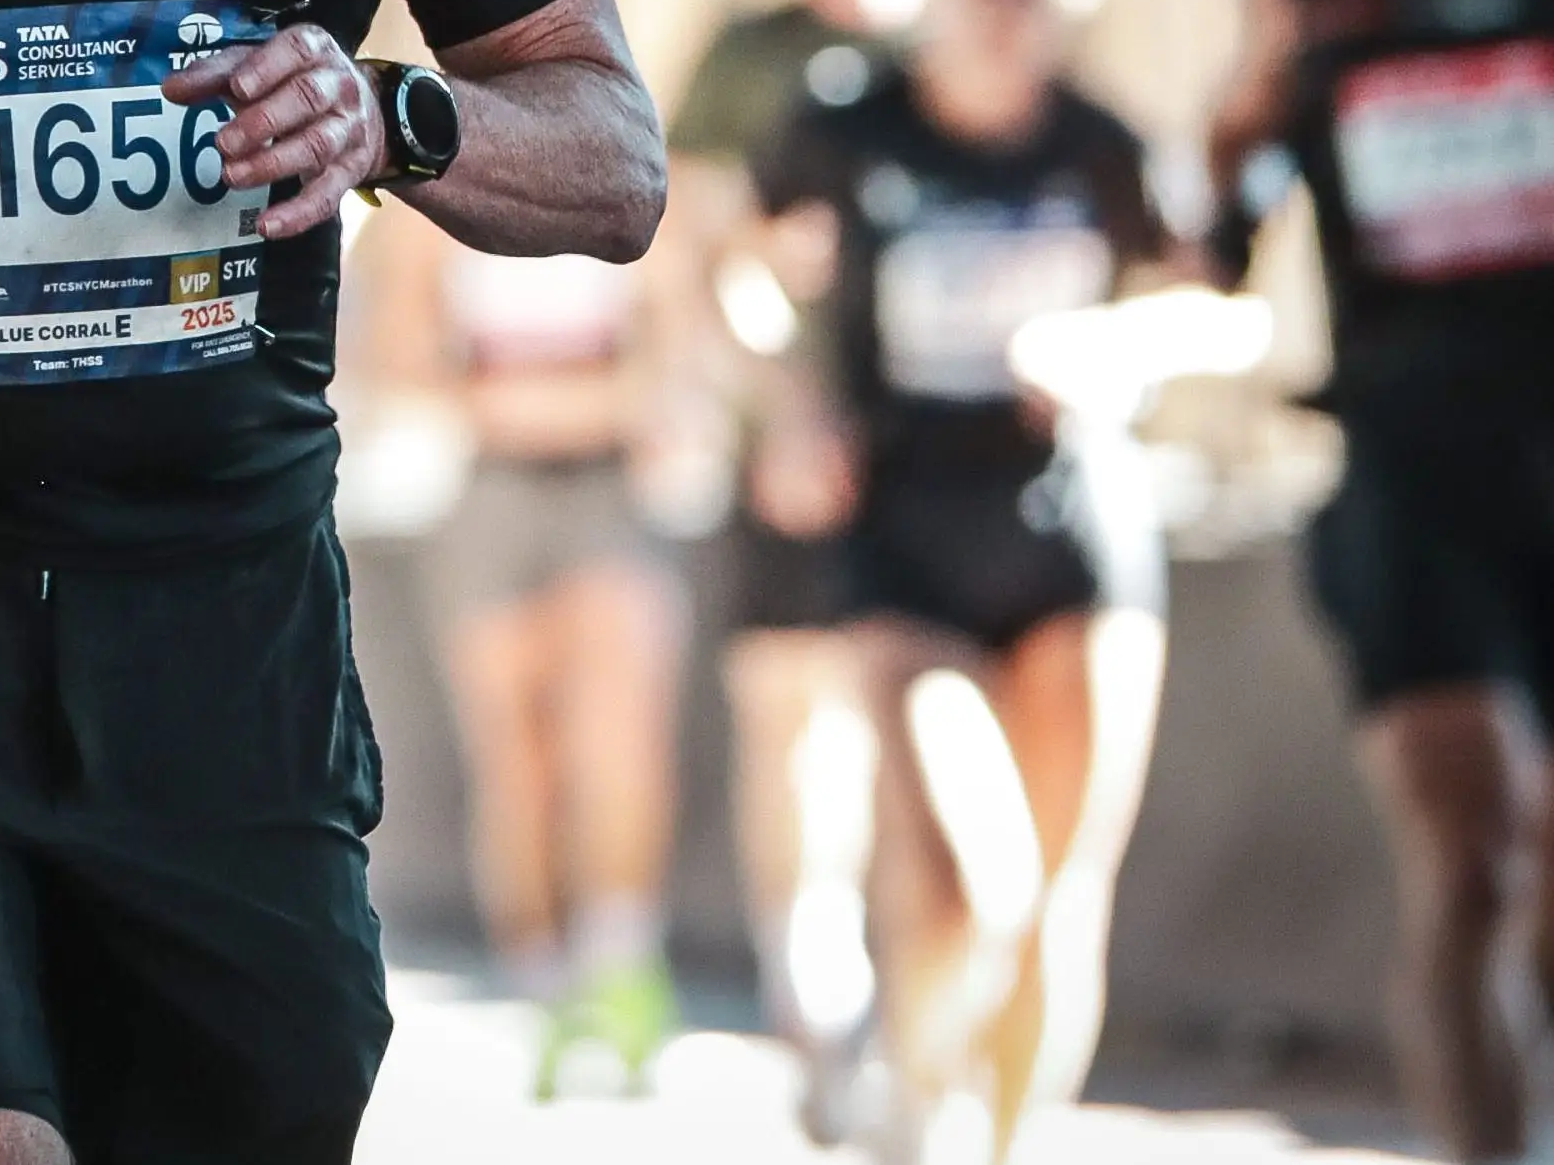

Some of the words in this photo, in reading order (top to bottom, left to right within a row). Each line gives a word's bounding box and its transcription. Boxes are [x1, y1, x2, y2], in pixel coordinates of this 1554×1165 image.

[17, 24, 70, 43] TATA
[17, 39, 138, 63] CONSULTANCY
[18, 60, 96, 81] SERVICES
[222, 257, 258, 281] STK
[43, 276, 154, 294] #TCSNYCMarathon
[179, 272, 211, 295] VIP
[38, 322, 112, 341] CORRAL
[115, 314, 132, 338] E
[181, 301, 236, 331] 2025
[33, 359, 70, 371] Team:
